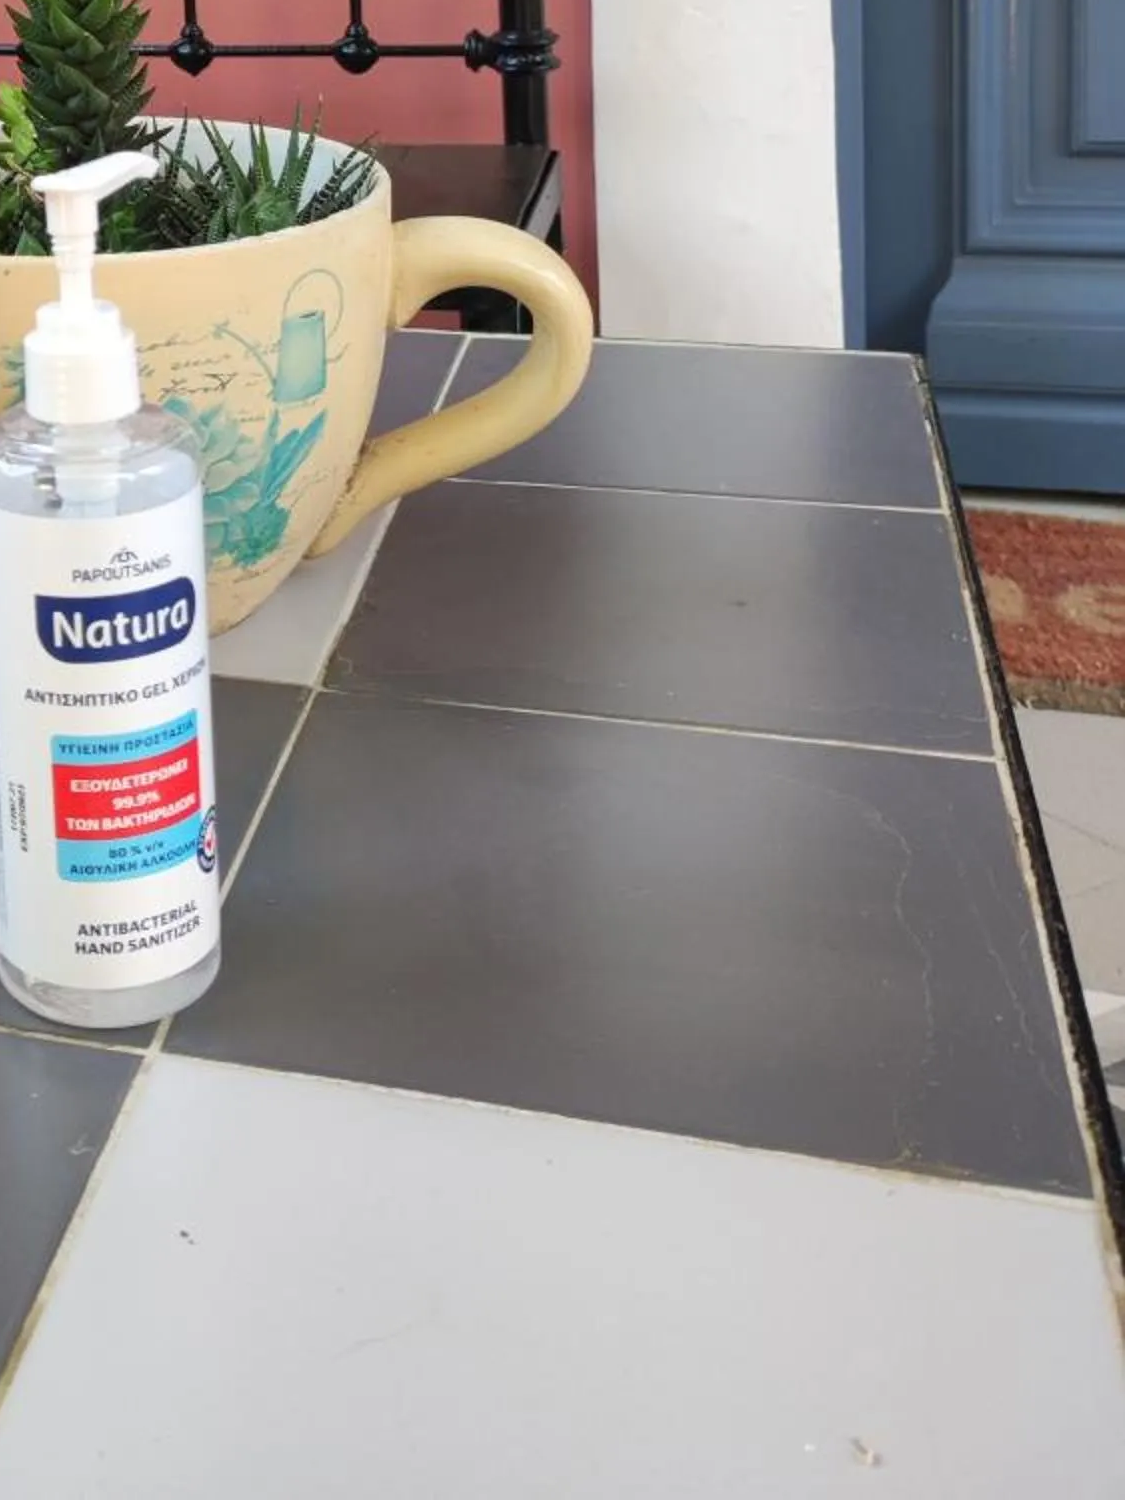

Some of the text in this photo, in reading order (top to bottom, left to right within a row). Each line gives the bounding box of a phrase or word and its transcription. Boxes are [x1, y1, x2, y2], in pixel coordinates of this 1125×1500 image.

[72, 553, 172, 583] PAPOUTSANIS
[52, 597, 189, 650] Natura
[25, 687, 138, 707] ΑΝΤΙΣΗΠΤΙΚΟ
[142, 681, 169, 699] GEL
[111, 790, 161, 811] 99.9%
[74, 915, 201, 955] HAND SANITIZER
[78, 899, 198, 937] ANTIBACTERIAL
